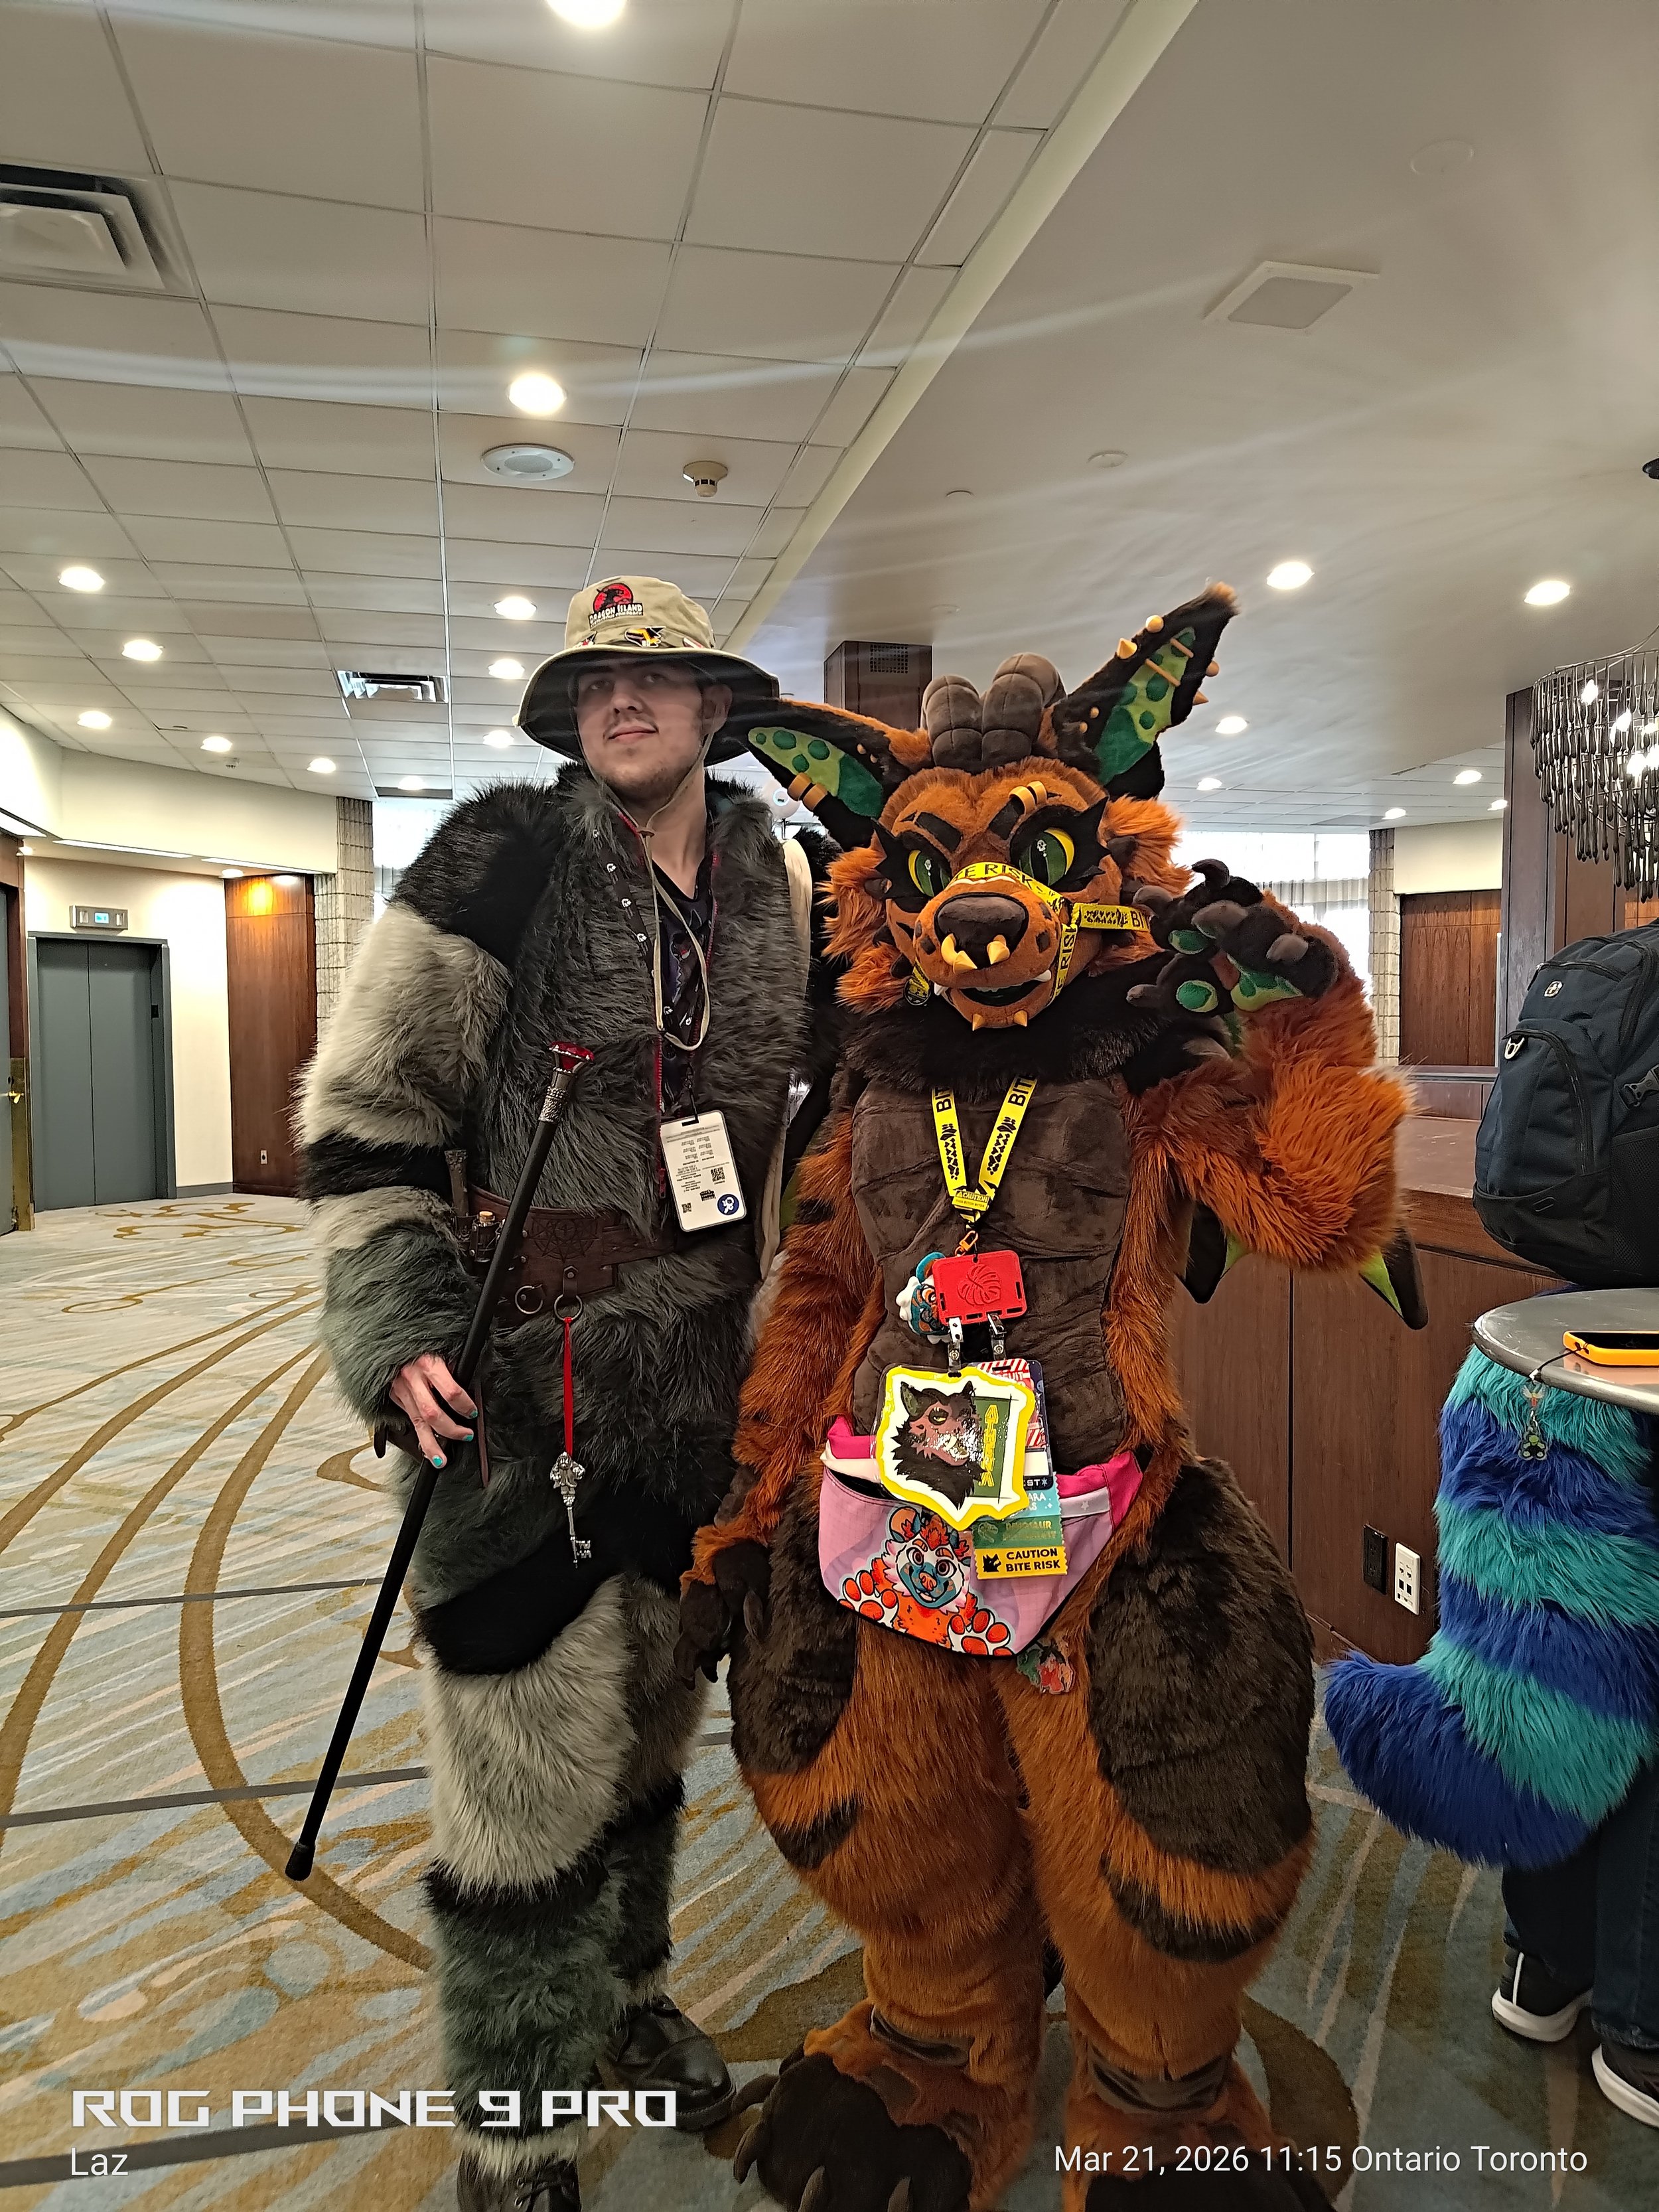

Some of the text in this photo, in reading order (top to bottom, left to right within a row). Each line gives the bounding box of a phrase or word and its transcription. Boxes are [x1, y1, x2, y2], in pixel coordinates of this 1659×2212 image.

[589, 607, 616, 625] DRAGON
[984, 863, 1033, 890] RISK
[962, 1192, 987, 1203] CAUTION
[1005, 1520, 1052, 1530] DINOSAUR
[1006, 1548, 1058, 1560] CAUTION
[1006, 1560, 1060, 1572] BITE RISK
